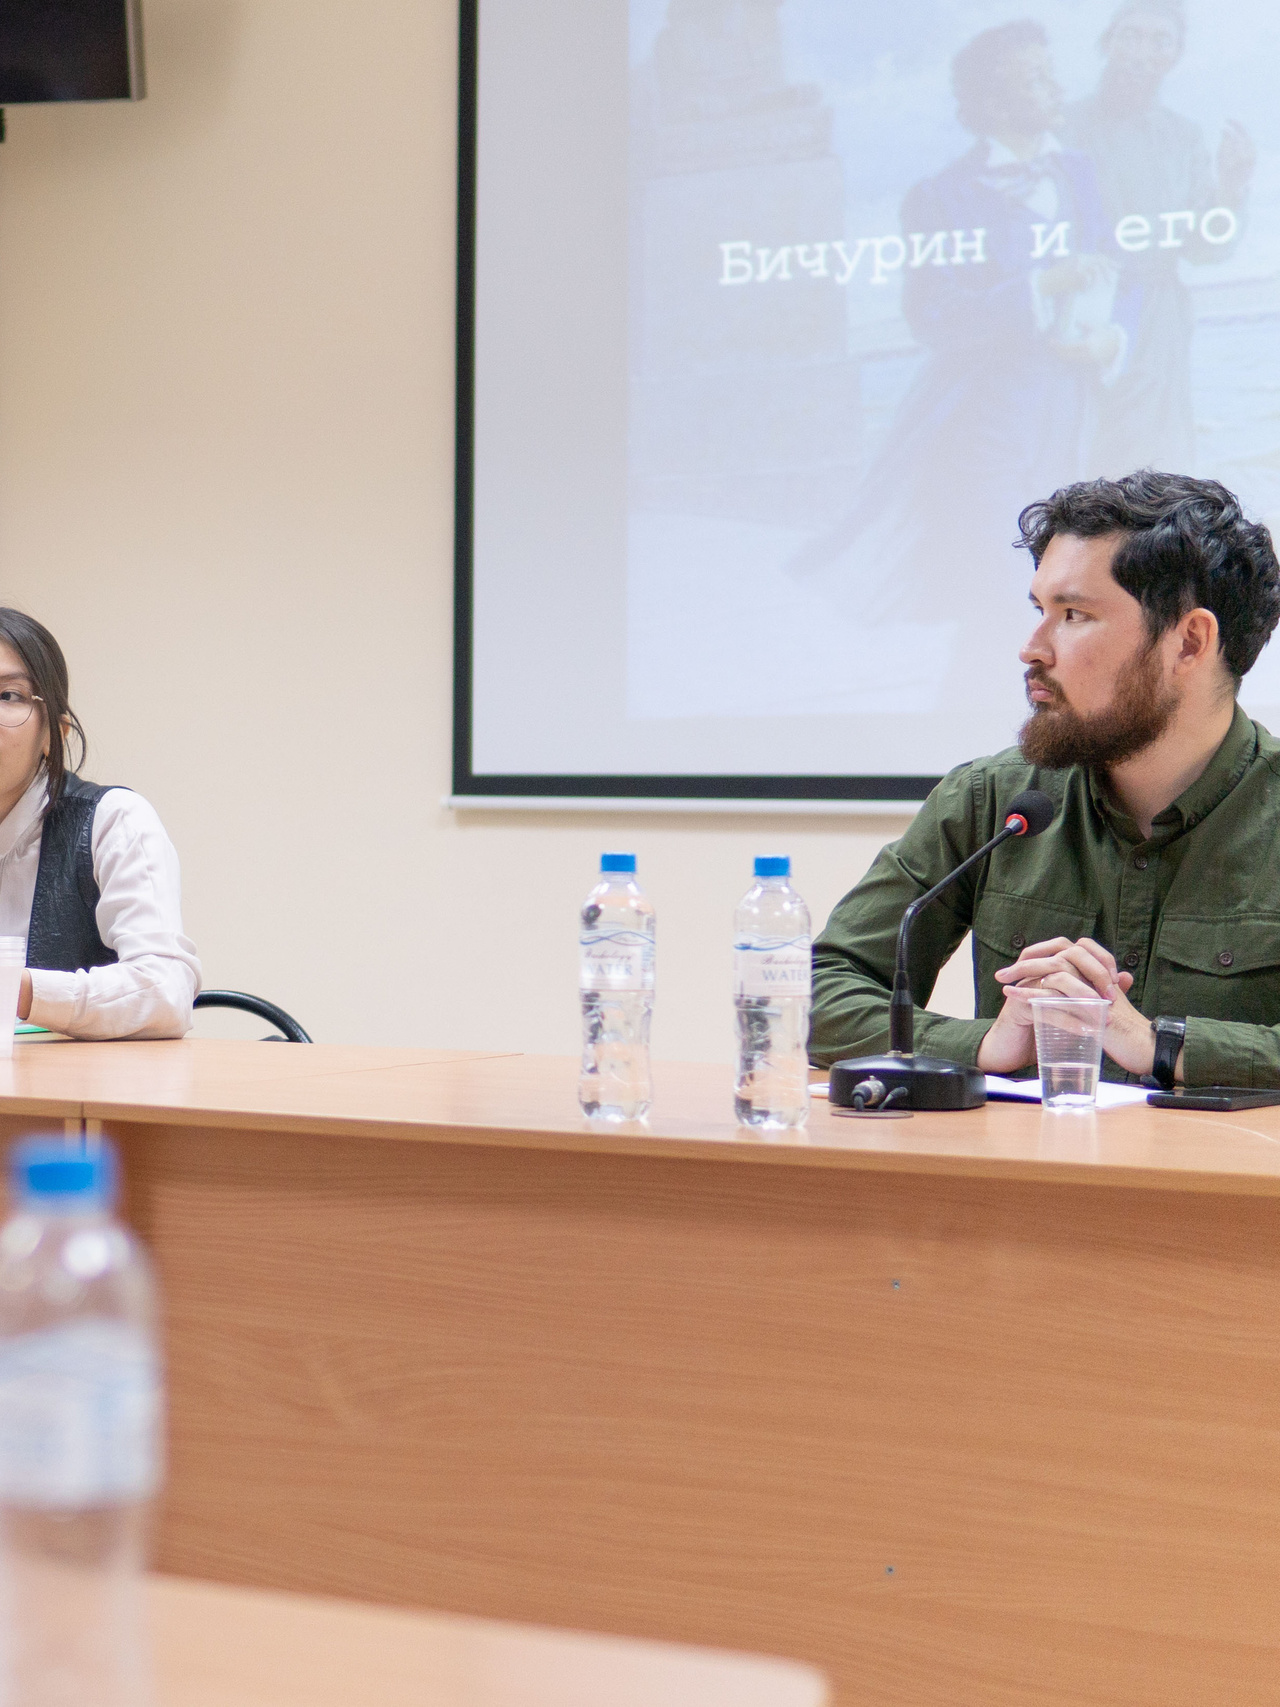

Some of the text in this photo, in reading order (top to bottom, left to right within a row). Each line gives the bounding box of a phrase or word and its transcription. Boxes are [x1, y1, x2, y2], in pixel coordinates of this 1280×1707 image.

[718, 207, 1238, 285] Бичурин и его
